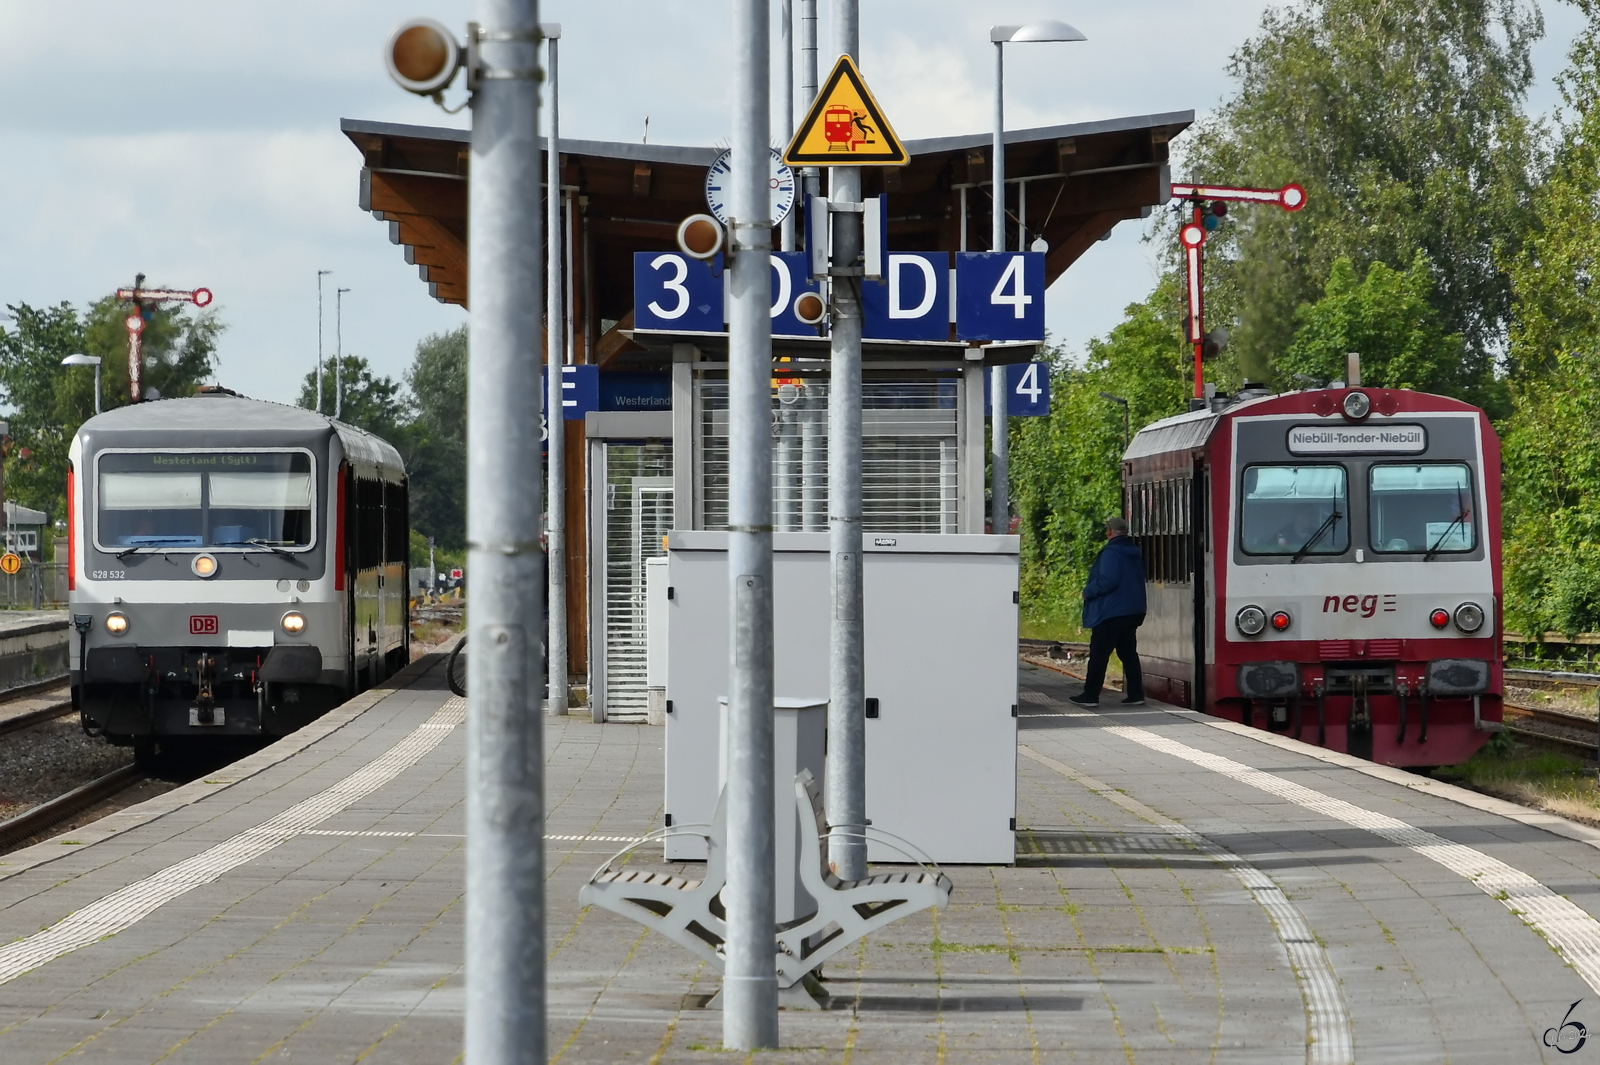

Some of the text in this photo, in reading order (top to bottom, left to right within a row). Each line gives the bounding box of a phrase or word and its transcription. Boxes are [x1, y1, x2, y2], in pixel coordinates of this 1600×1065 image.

[647, 253, 690, 320] 3
[888, 254, 937, 319] D
[990, 255, 1032, 319] 4
[1015, 363, 1042, 403] 4
[153, 455, 257, 466] Westerland (Sylt)
[92, 570, 125, 579] 628 532
[1322, 594, 1378, 618] neg
[193, 618, 215, 632] DB
